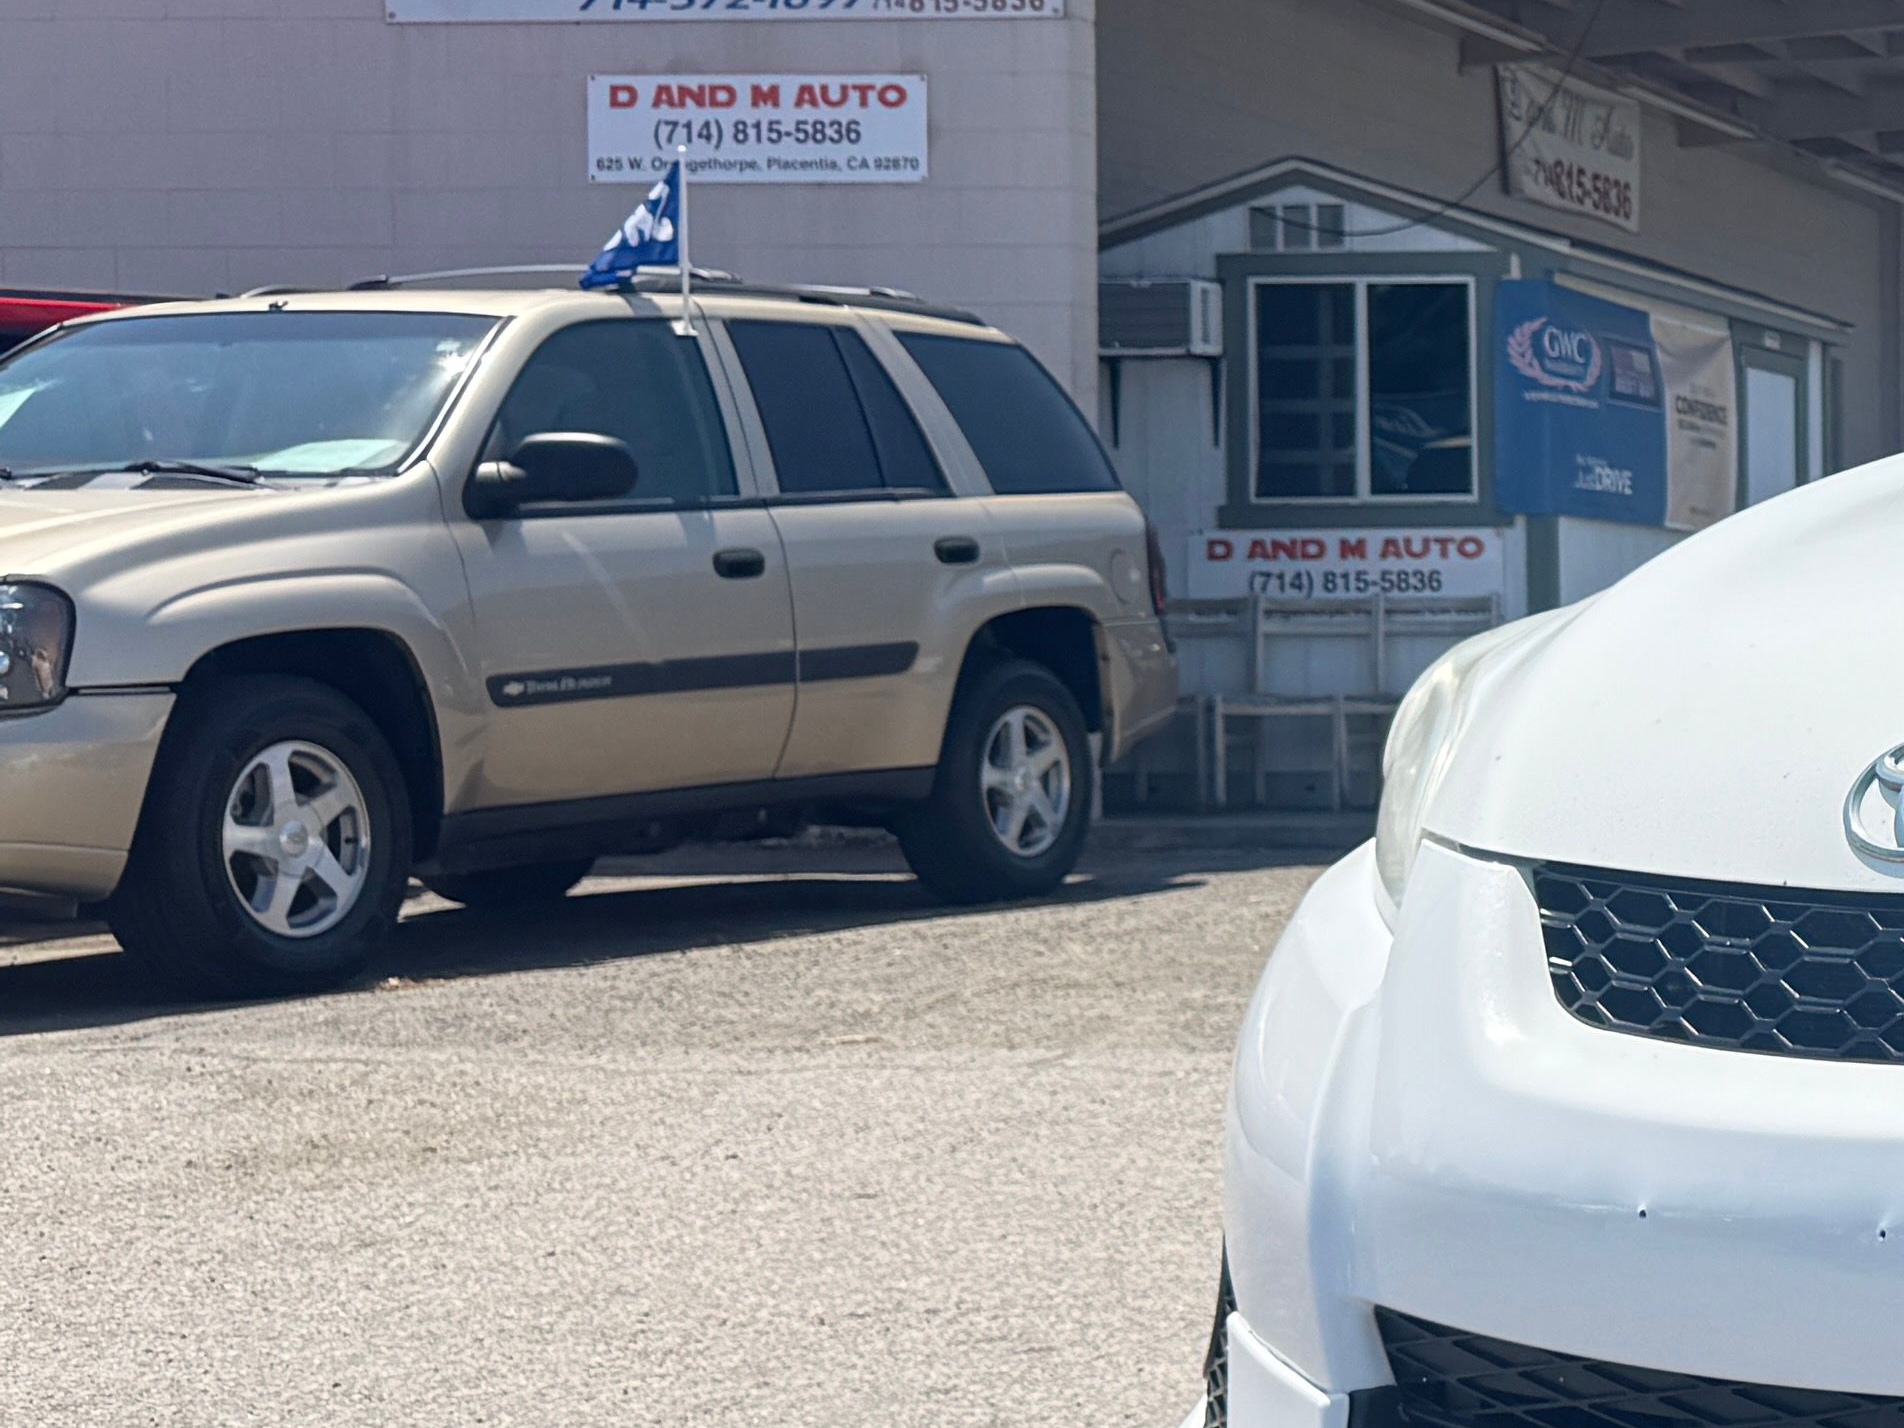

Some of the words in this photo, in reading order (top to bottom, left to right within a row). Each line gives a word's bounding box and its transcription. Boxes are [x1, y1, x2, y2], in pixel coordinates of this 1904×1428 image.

[609, 84, 638, 108] D
[652, 84, 737, 108] AND
[751, 84, 780, 108] M
[794, 83, 908, 108] AUTO
[653, 119, 723, 150] (714)
[732, 119, 862, 145] 815-5836
[847, 155, 870, 172] CA
[1543, 325, 1588, 364] GWC
[1206, 538, 1233, 562] D
[1247, 537, 1326, 562] AND
[1340, 537, 1366, 560] M
[1379, 535, 1485, 560] AUTO
[1249, 570, 1314, 599] (714)
[1322, 570, 1442, 593] 815-5836
